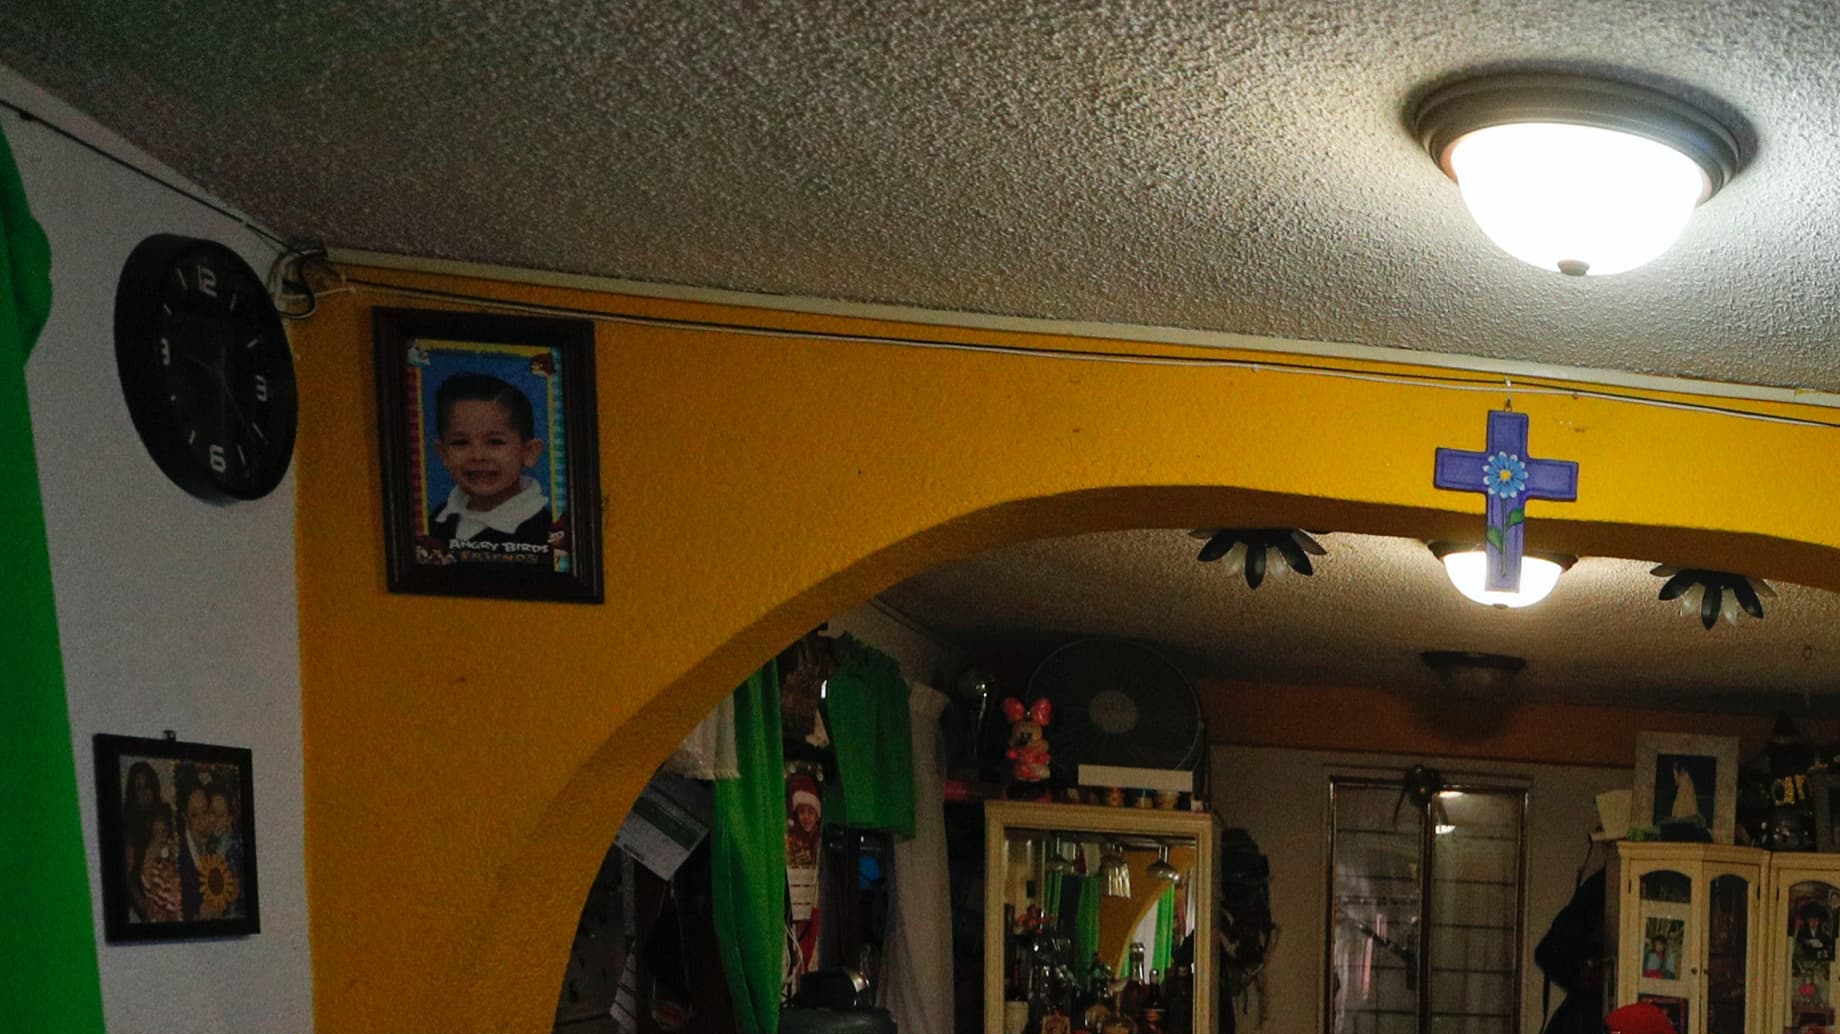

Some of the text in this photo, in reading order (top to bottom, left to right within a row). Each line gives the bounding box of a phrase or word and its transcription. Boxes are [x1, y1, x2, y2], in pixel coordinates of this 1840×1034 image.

[208, 443, 227, 474] 6
[449, 538, 550, 553] ANGRY BIRDS
